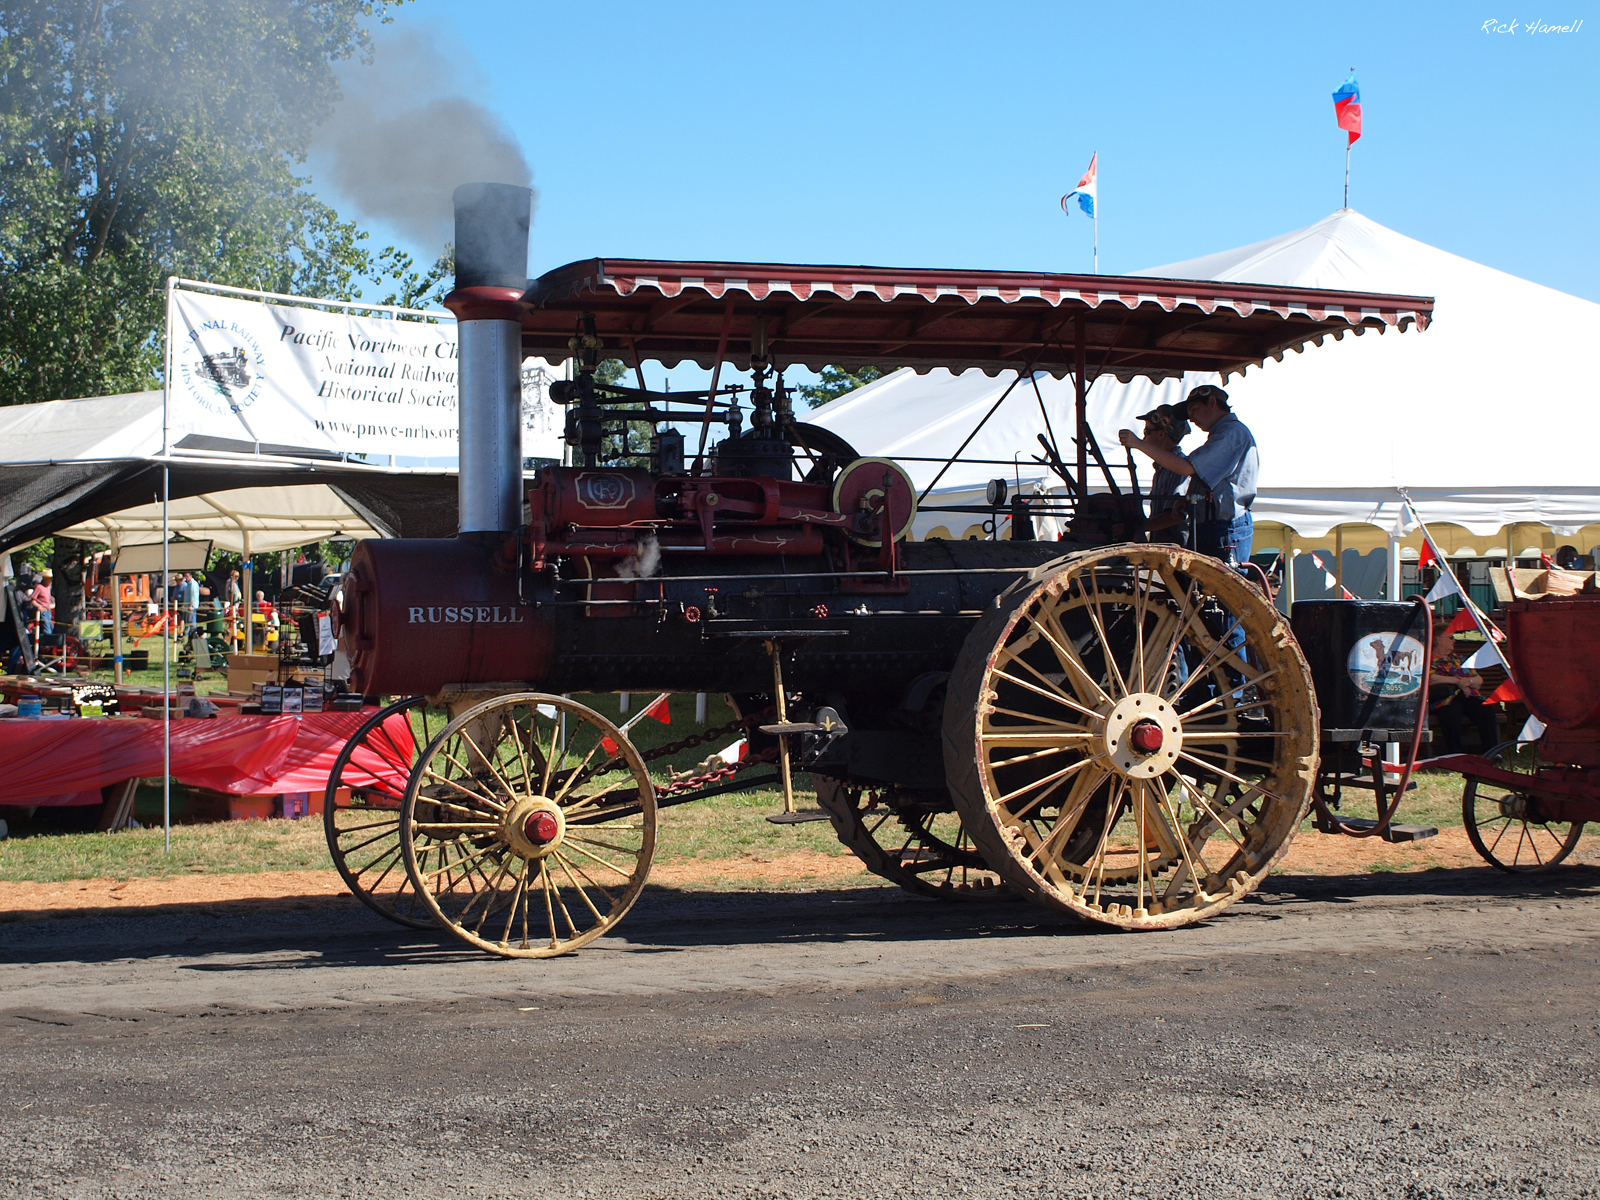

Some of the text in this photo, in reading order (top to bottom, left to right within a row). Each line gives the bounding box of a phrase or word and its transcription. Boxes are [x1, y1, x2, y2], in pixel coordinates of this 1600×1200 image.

[230, 322, 266, 367] RAILWAY
[280, 324, 340, 352] Pacific
[346, 333, 429, 358] Northwest
[320, 355, 396, 379] National
[180, 363, 265, 415] HISTORICAL SOCIETY
[317, 380, 404, 404] Historical
[408, 606, 524, 623] RUSSELL
